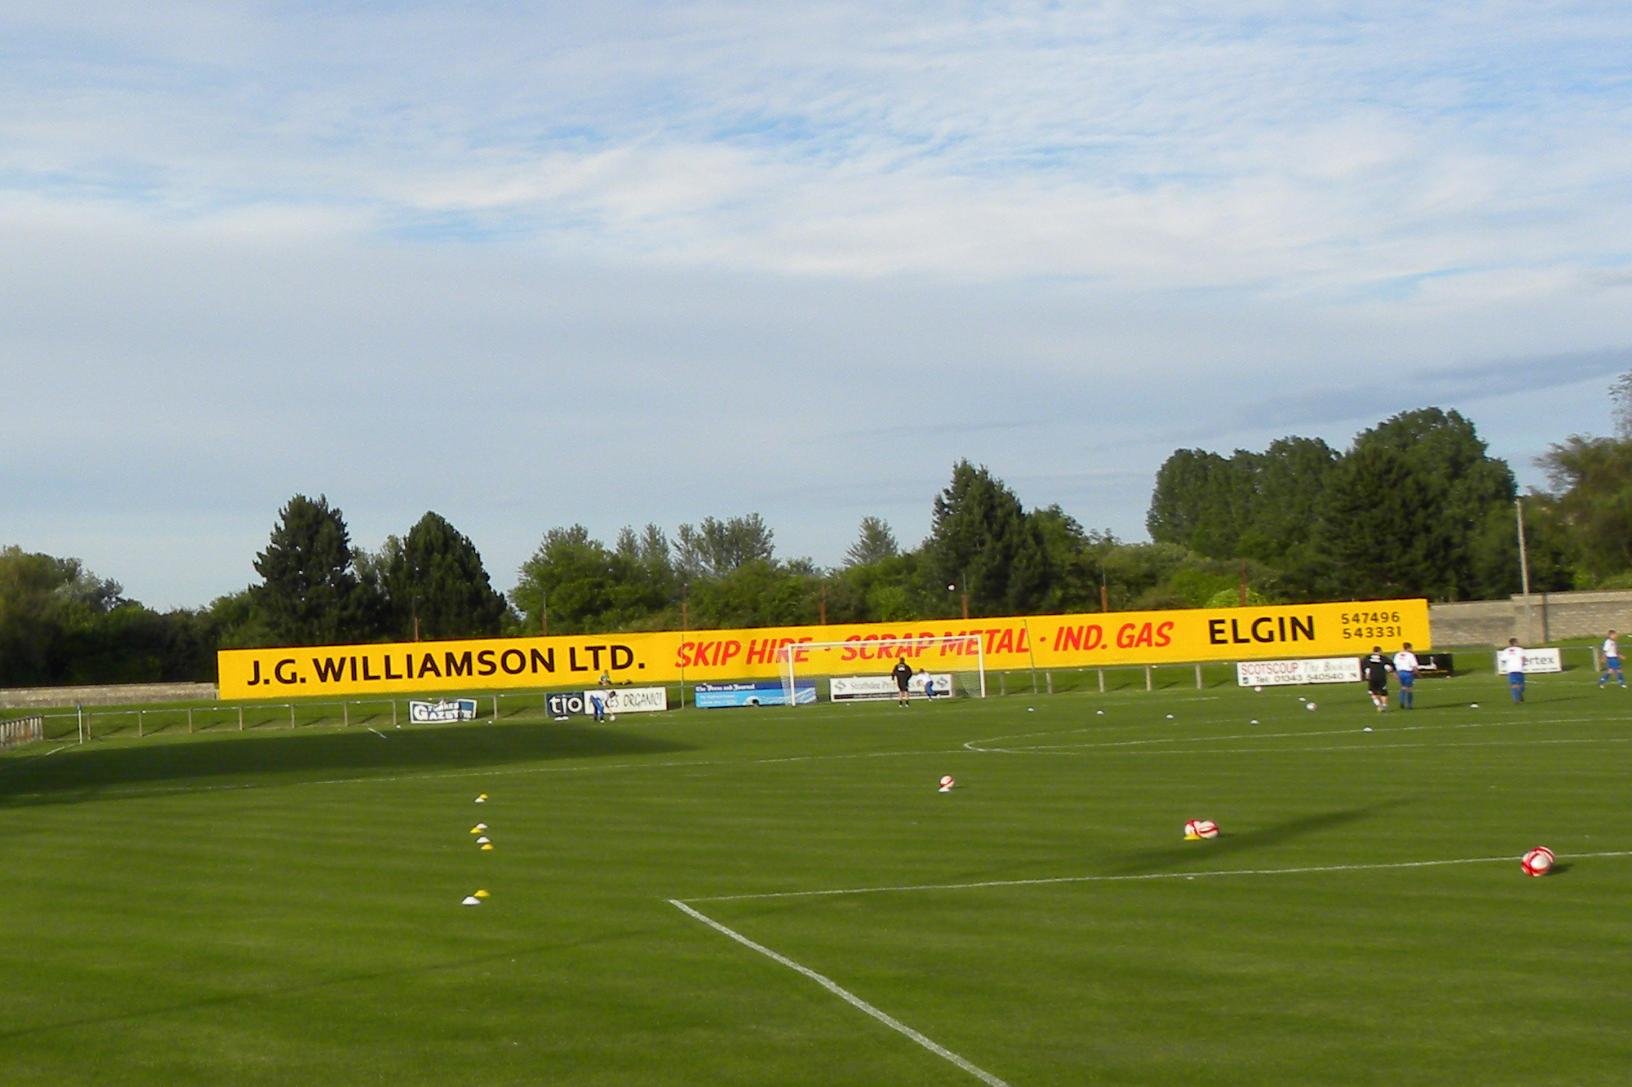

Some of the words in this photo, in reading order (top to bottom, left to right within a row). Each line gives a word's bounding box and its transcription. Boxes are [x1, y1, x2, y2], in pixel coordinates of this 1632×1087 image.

[675, 640, 742, 668] SKIP
[745, 637, 813, 665] HIRE
[841, 634, 934, 661] SCRAP
[940, 629, 1030, 656] METAL
[1053, 624, 1108, 652] IND.
[1116, 621, 1174, 648] GAS
[1209, 615, 1315, 645] ELGIN
[1341, 611, 1400, 624] 547496
[1342, 626, 1402, 639] 543331
[247, 659, 306, 686] J.G.
[312, 647, 555, 683] WILLIAMSON
[569, 645, 645, 672] LTD.
[1241, 662, 1298, 675] SCOTSCOUP
